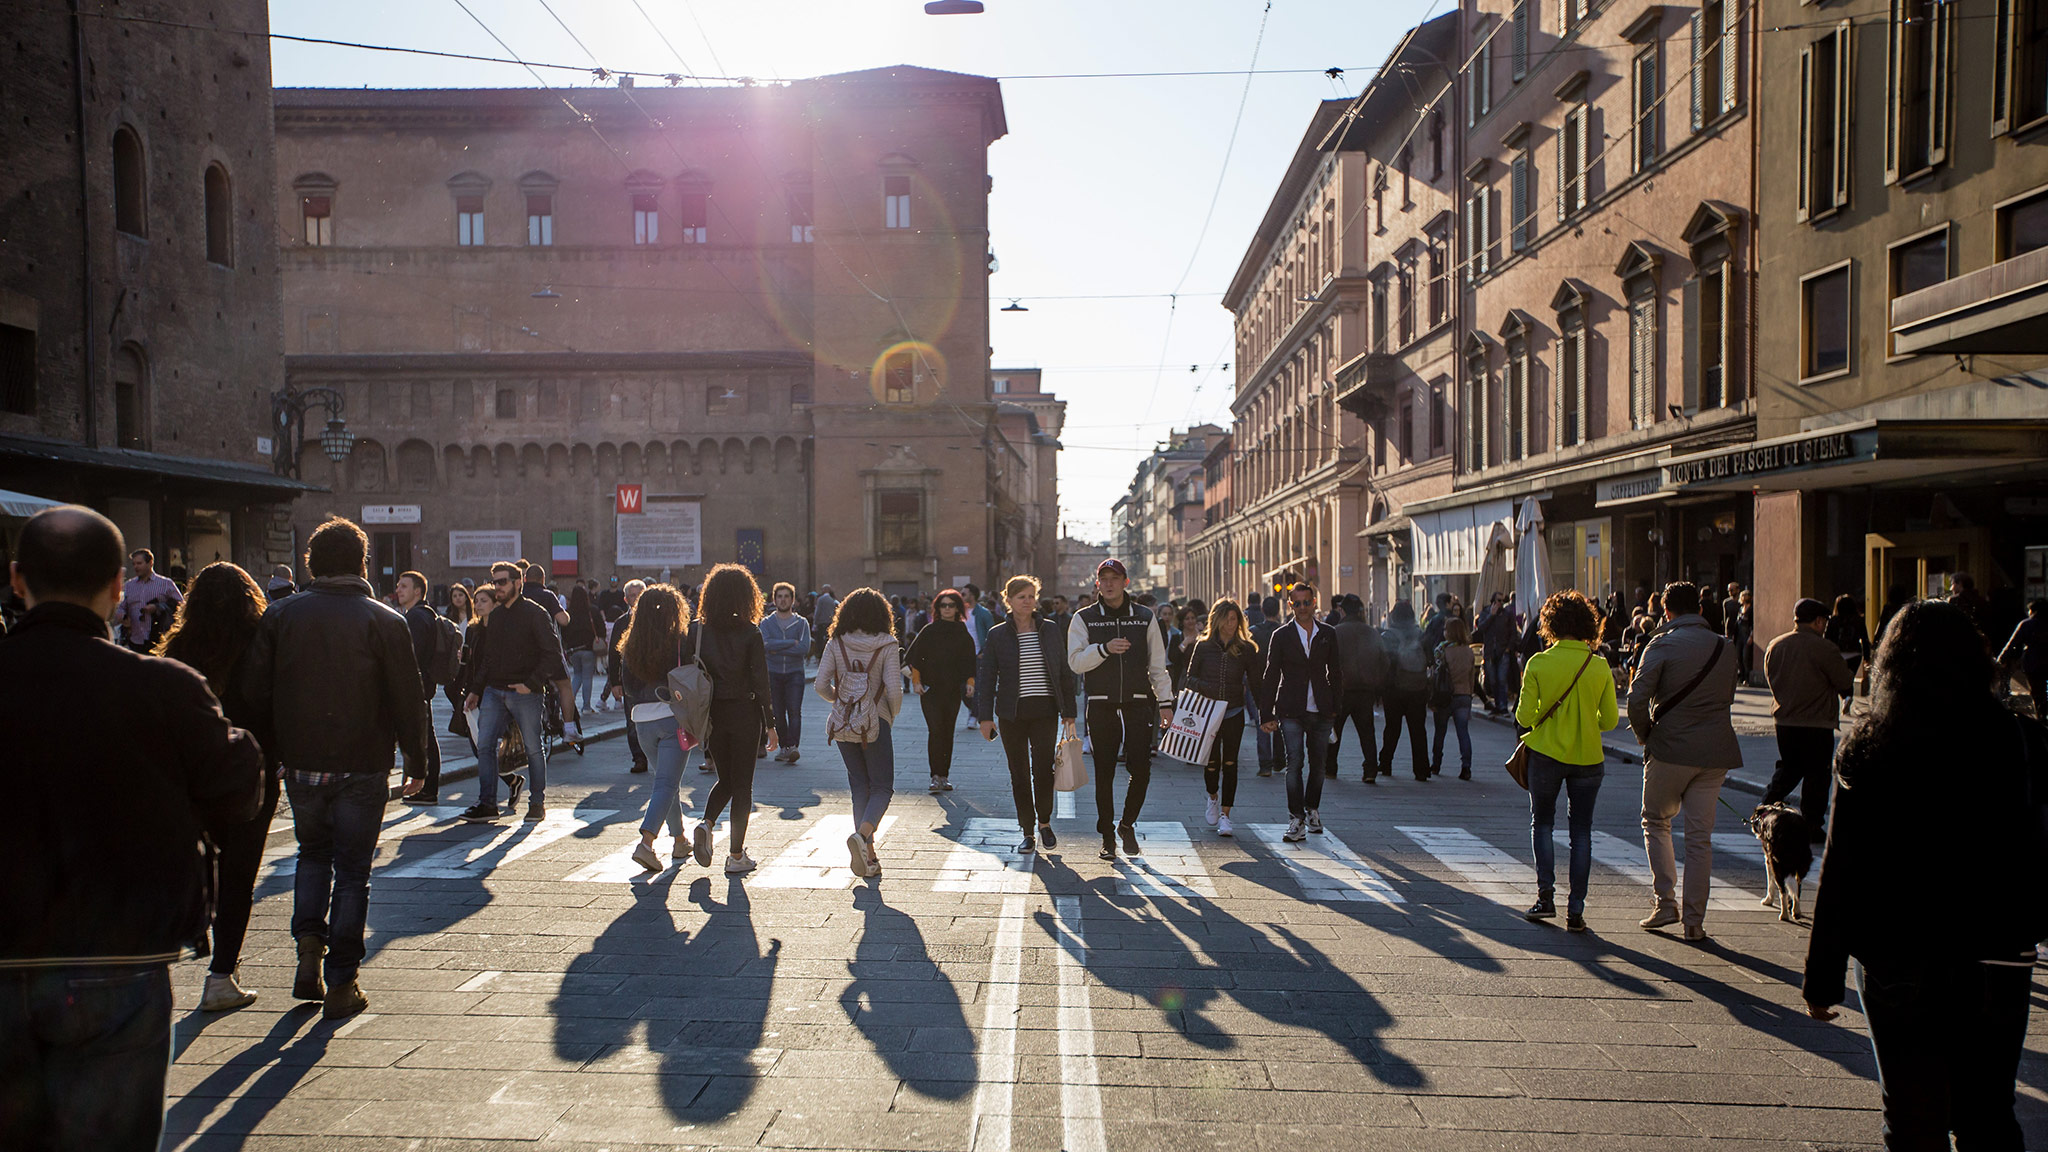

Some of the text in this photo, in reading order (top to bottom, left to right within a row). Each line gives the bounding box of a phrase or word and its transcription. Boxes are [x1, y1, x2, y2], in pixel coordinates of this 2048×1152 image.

[1670, 433, 1848, 483] MONTE DEI PASCHI DI SIENA
[620, 489, 639, 508] W
[1610, 477, 1659, 500] CAFFETTERIA
[1171, 723, 1183, 731] Foot
[1183, 727, 1201, 737] Locker
